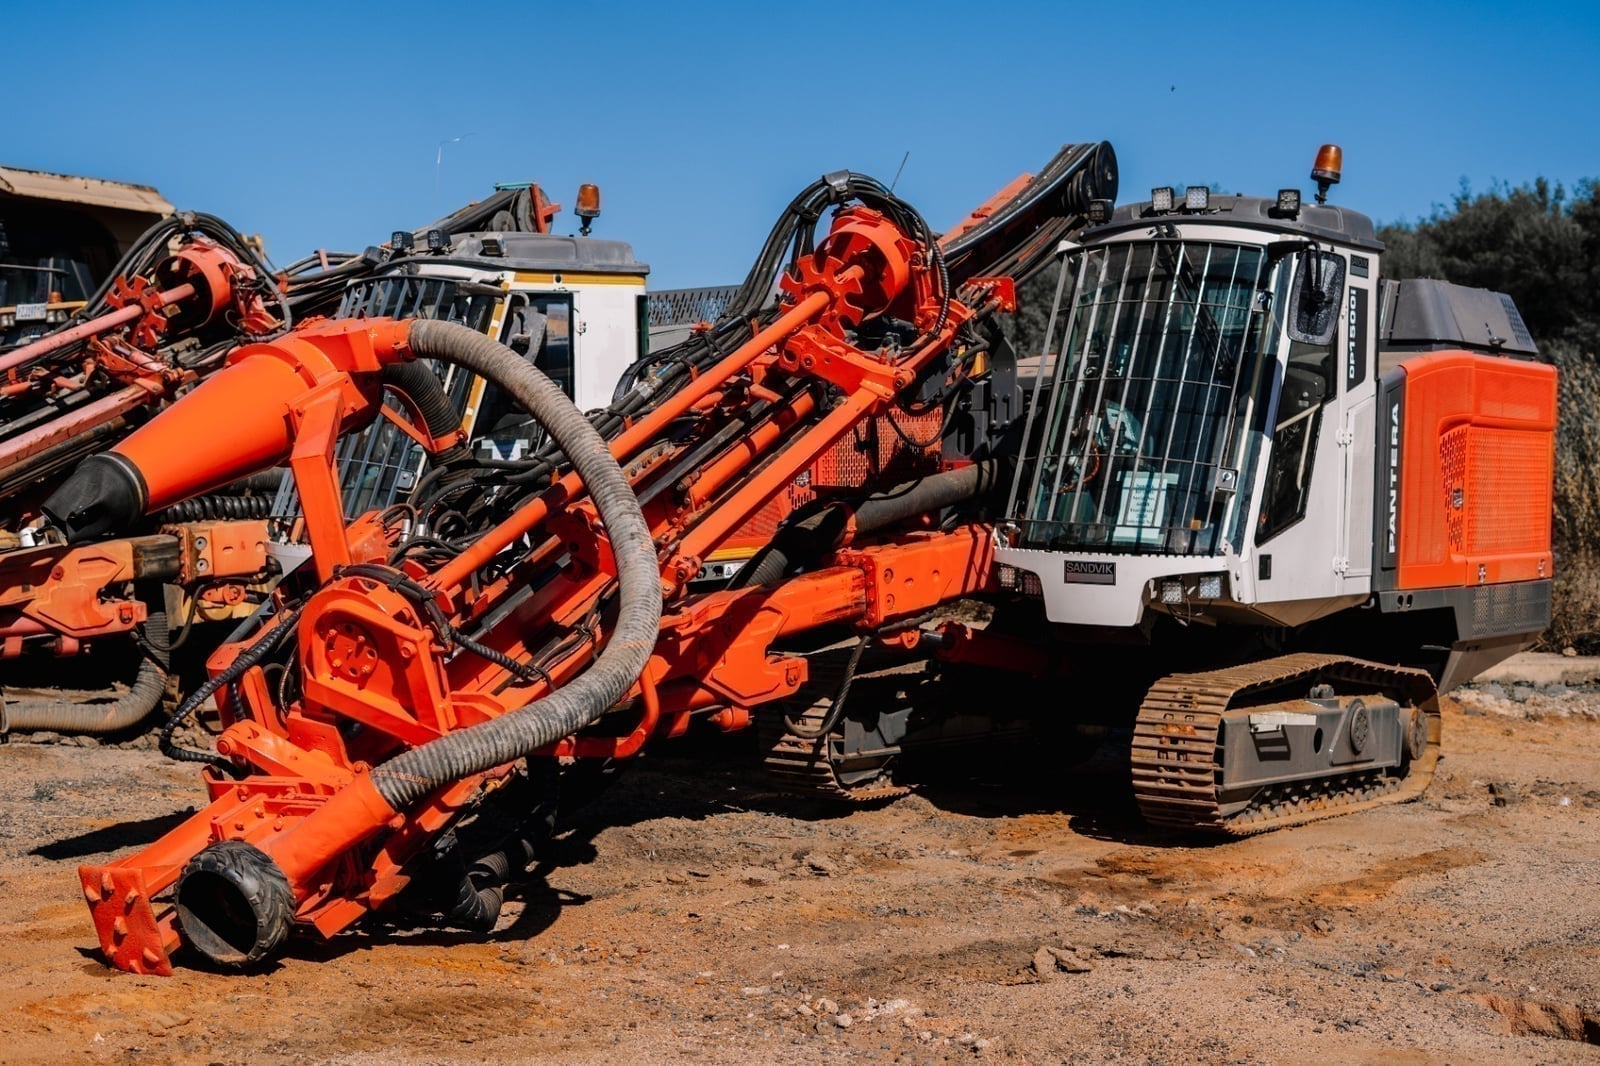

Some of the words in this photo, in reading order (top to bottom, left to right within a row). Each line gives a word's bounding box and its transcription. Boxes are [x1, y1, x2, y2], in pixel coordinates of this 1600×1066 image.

[1348, 289, 1357, 379] DP1500i
[1388, 402, 1399, 554] PANTERA
[1066, 562, 1113, 574] SANDVIK
